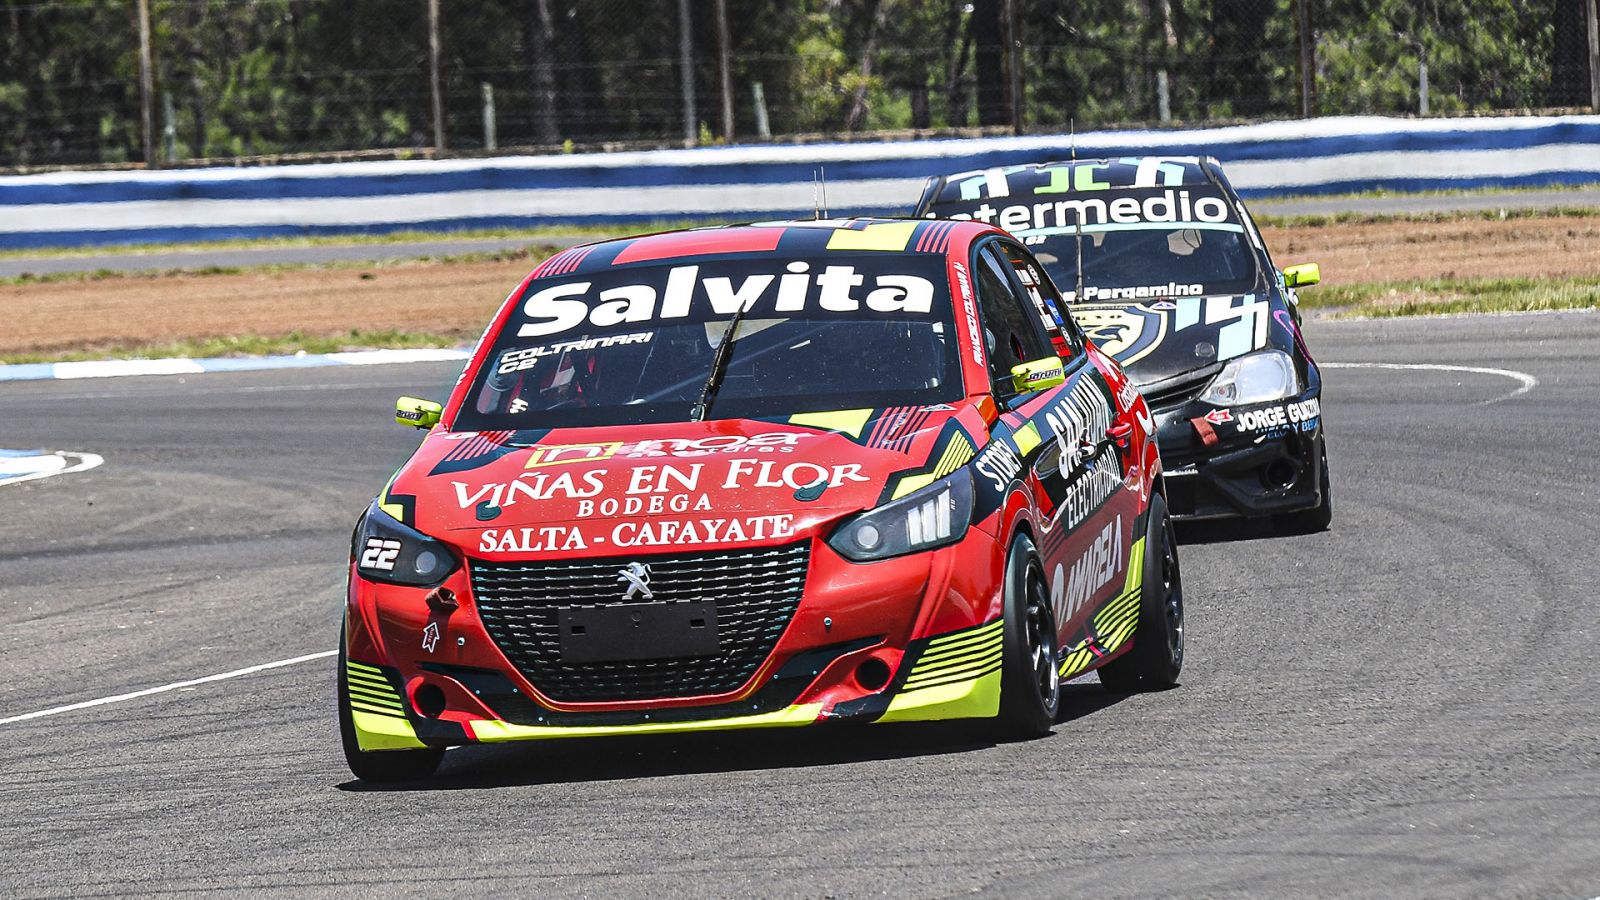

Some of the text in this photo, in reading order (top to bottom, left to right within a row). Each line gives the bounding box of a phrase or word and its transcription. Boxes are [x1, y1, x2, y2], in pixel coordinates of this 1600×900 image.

[925, 190, 1228, 231] termedio
[516, 261, 934, 337] Salvita
[1083, 282, 1203, 300] Pergamino
[500, 332, 653, 363] COLTRINARI
[1236, 406, 1287, 432] JORGE
[976, 437, 1022, 492] STOREY
[450, 458, 870, 510] VIÑAS EN FLOR
[576, 493, 714, 518] BODEGA
[479, 527, 586, 553] SALTA
[610, 514, 795, 549] CAFAYATE
[360, 537, 402, 571] 22
